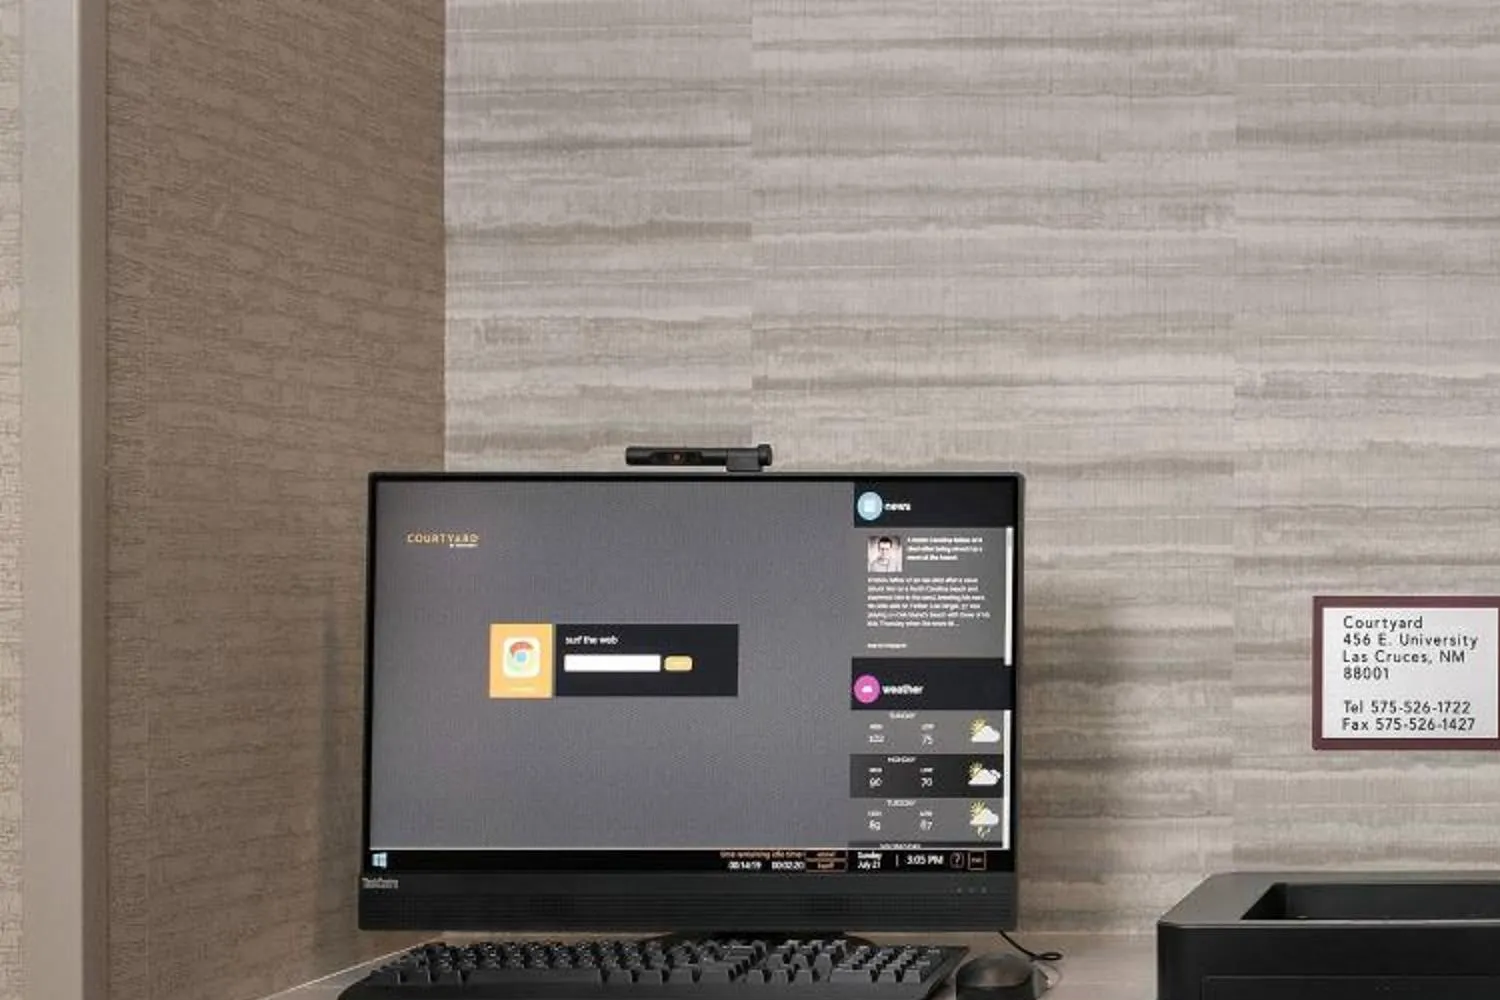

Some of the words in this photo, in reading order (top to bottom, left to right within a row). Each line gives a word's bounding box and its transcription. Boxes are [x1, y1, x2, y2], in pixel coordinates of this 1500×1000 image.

[1343, 615, 1423, 632] Courtyard
[1343, 633, 1371, 647] 456
[1378, 633, 1392, 647] E.
[1399, 633, 1478, 650] University
[1343, 650, 1368, 663] Las
[1375, 650, 1433, 664] Cruces,
[1439, 650, 1465, 663] NM
[1343, 667, 1389, 680] 88001
[882, 684, 924, 695] weather
[1344, 700, 1363, 714] Tel
[1371, 700, 1471, 714] 575-526-1722
[1342, 717, 1369, 731] Fax
[1376, 717, 1475, 731] 575-526-1427
[927, 854, 944, 865] PM
